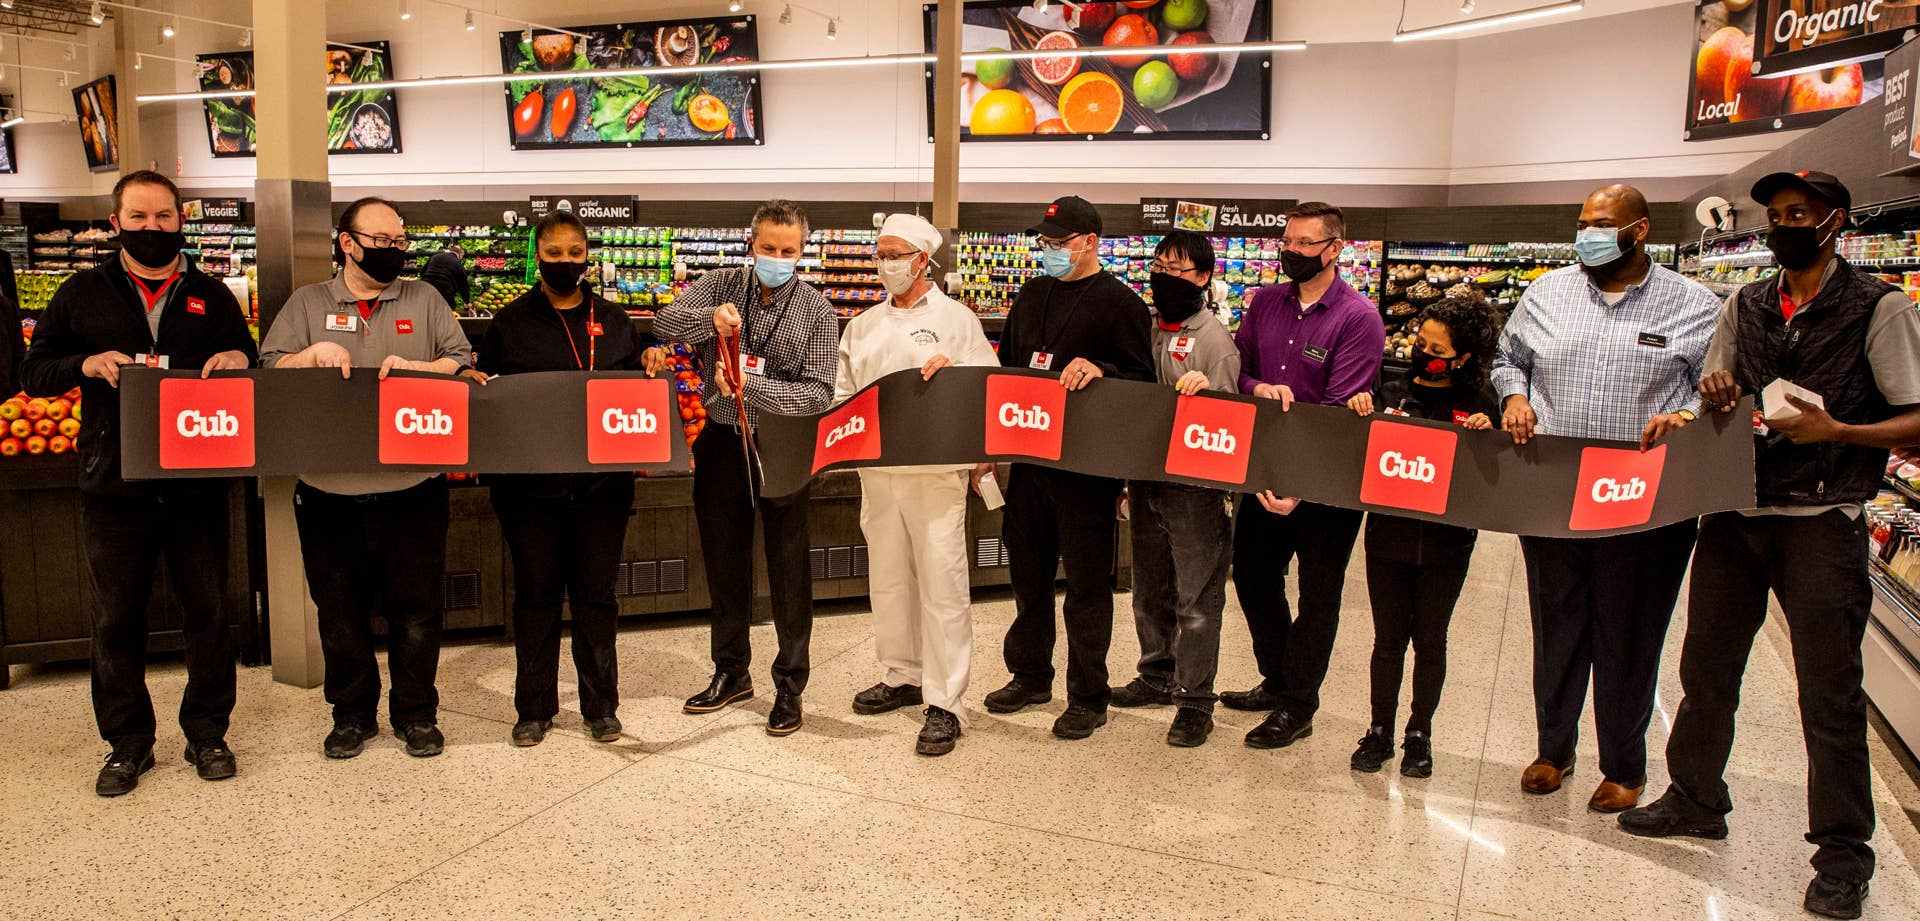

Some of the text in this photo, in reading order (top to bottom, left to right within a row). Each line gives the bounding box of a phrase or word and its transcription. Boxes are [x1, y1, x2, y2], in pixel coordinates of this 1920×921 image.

[1774, 0, 1883, 45] Organic
[1885, 69, 1909, 106] BEST
[1697, 94, 1741, 121] Local
[1883, 103, 1906, 132] produce
[204, 207, 239, 216] VEGGIES
[531, 200, 549, 208] BEST
[579, 207, 631, 218] ORGANIC
[1143, 204, 1168, 213] BEST
[1220, 205, 1239, 214] fresh
[1220, 214, 1287, 227] SALADS
[177, 409, 239, 438] Cub
[396, 407, 454, 435] Cub
[603, 407, 658, 434] Cub
[999, 402, 1051, 431] Cub
[825, 415, 866, 448] Cub
[1184, 423, 1237, 455] Cub
[1380, 451, 1437, 483] Cub
[1591, 477, 1647, 503] Cub
